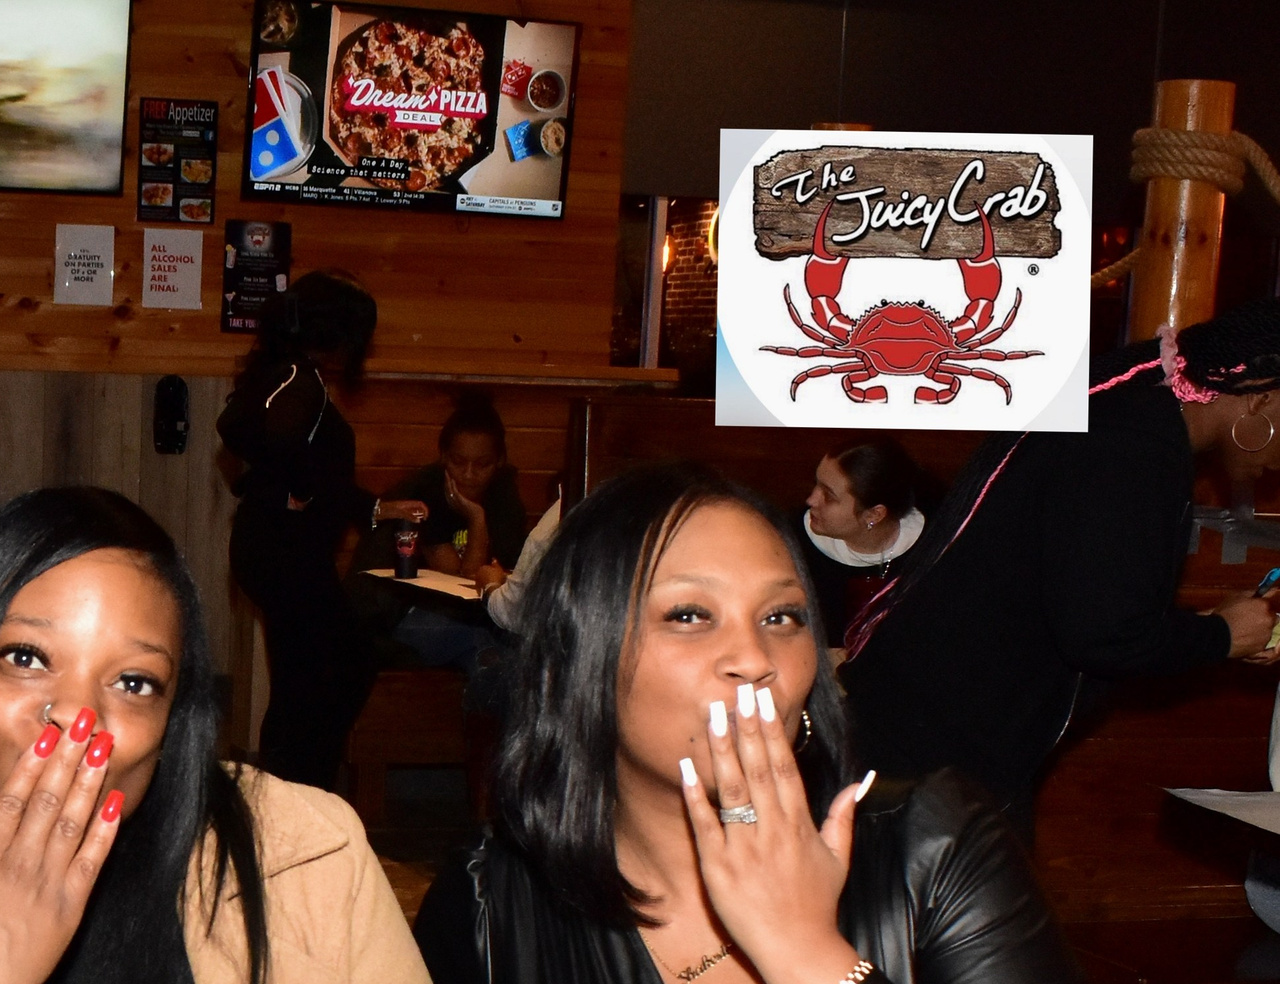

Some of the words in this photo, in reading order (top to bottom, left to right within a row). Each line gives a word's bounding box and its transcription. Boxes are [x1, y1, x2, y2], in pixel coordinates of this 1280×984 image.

[350, 79, 431, 110] Dream
[440, 90, 488, 114] PIZZA
[143, 100, 167, 119] FREE
[168, 102, 215, 125] Appetizer
[402, 112, 436, 122] DEAL
[361, 158, 377, 167] One
[380, 159, 386, 167] A
[389, 160, 407, 170] Day.
[311, 165, 345, 176] Science
[350, 168, 368, 177] that
[309, 185, 337, 194] Marquette
[150, 244, 167, 253] ALL
[67, 253, 101, 261] GRATUITY
[151, 254, 195, 264] ALCOHOL
[77, 261, 104, 269] PARTIES
[151, 264, 178, 273] SALES
[150, 274, 168, 282] ARE
[229, 318, 243, 328] TAKE
